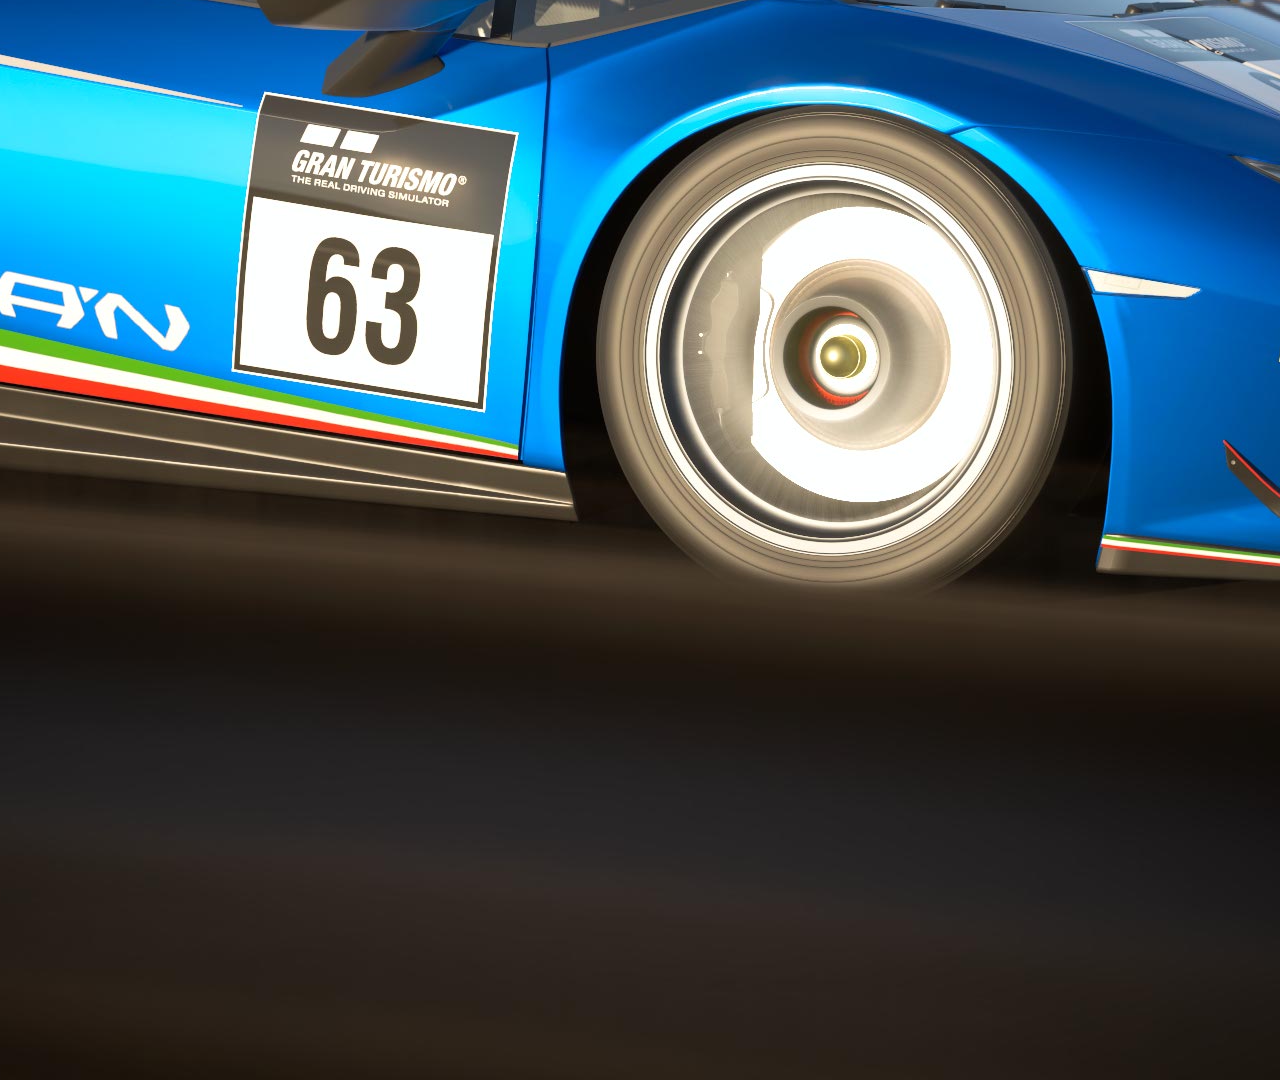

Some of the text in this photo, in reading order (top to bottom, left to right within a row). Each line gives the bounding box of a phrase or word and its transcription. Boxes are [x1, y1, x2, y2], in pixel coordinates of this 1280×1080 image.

[291, 149, 356, 180] GRAN
[291, 174, 450, 207] THE REAL DRIVING SIMULATOR
[306, 236, 422, 366] 63
